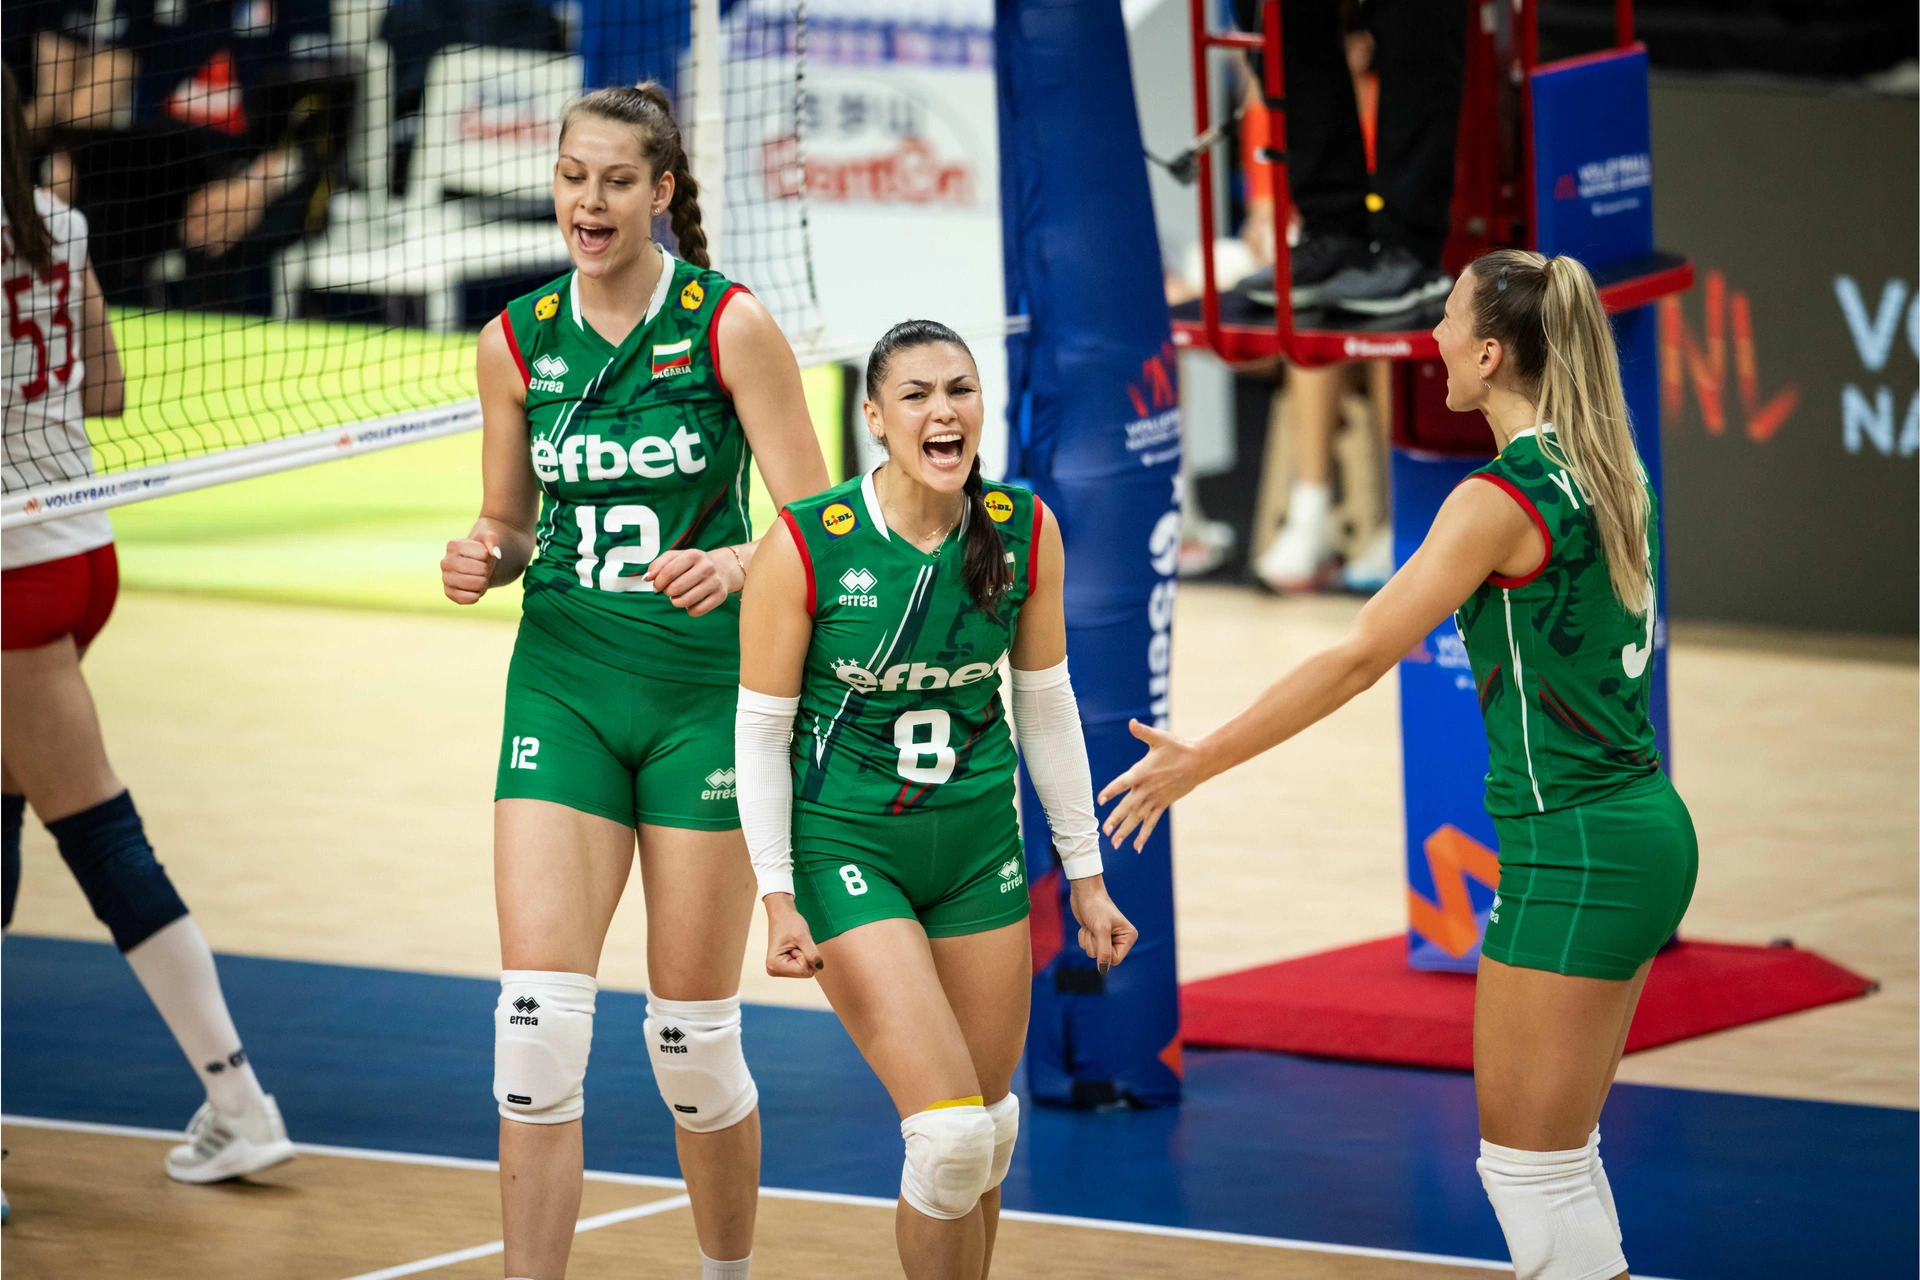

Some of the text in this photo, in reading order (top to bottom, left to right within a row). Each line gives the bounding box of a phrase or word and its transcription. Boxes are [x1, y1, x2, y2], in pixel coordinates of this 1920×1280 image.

[5, 261, 74, 401] 53
[1834, 273, 1919, 373] V
[529, 377, 564, 393] errea
[531, 426, 706, 483] efbet
[45, 484, 118, 508] VOLLEYBALL
[575, 505, 660, 592] 12
[839, 594, 878, 608] errea
[510, 736, 540, 770] 12
[894, 709, 956, 784] 8
[839, 864, 868, 896] 8
[1000, 873, 1023, 893] errea
[510, 1015, 538, 1026] errea
[660, 1043, 688, 1054] errea
